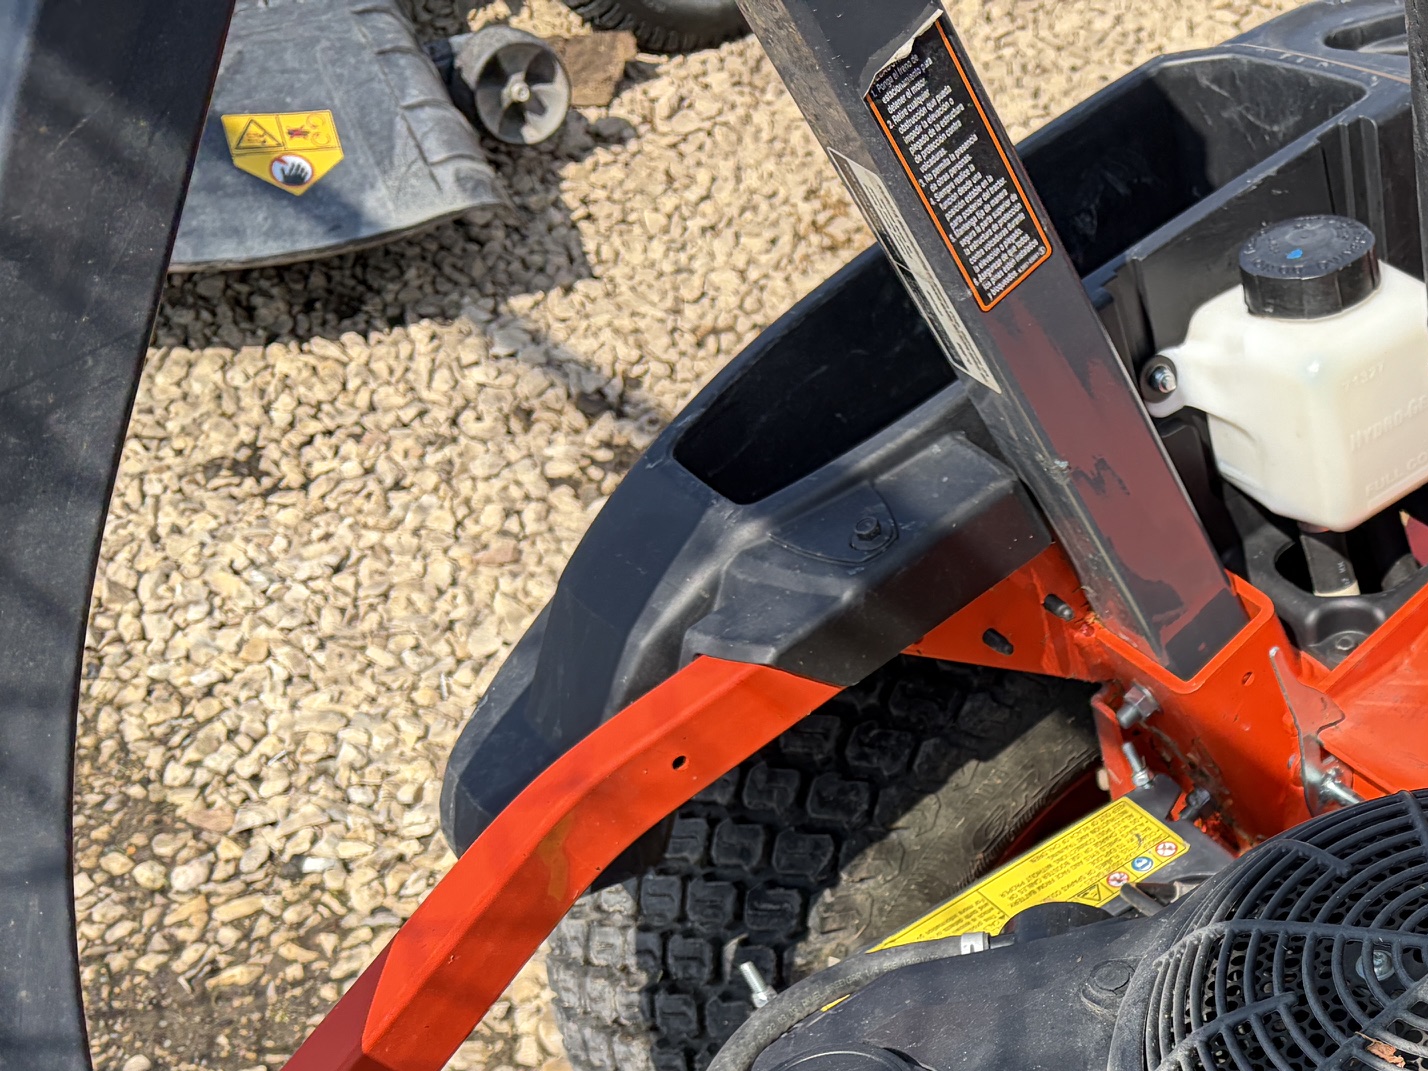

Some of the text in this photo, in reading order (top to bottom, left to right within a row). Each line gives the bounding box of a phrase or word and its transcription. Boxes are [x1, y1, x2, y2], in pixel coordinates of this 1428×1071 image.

[875, 73, 895, 95] Ponga
[890, 68, 900, 80] el
[896, 57, 912, 76] freno
[909, 51, 919, 65] de
[879, 64, 922, 105] estacionamiento
[918, 55, 934, 73] para
[885, 75, 928, 115] detener el motor.
[890, 105, 909, 125] Retire
[905, 86, 932, 115] cualquier
[896, 82, 954, 135] obstrucción que pueda
[901, 96, 955, 147] impedir la elevación o
[907, 100, 965, 157] plegado de la estructura
[912, 117, 963, 165] de protección contra
[917, 144, 948, 174] volcaduras.
[922, 170, 934, 184] No
[930, 155, 952, 179] permita
[947, 151, 956, 162] la
[952, 131, 980, 160] presencia
[928, 151, 974, 193] de otras personas.
[932, 179, 957, 204] Siempre
[951, 165, 971, 186] realice
[967, 161, 976, 173] la
[943, 172, 994, 223] posición estable en la
[955, 177, 973, 197] desde
[970, 170, 982, 184] una
[982, 201, 992, 214] de
[988, 187, 1009, 208] manera
[948, 213, 964, 231] parte
[960, 195, 985, 221] posterior
[980, 187, 992, 202] del
[958, 228, 978, 249] segura
[973, 223, 982, 234] la
[978, 213, 995, 232] parte
[1008, 190, 1018, 203] de
[962, 200, 1024, 257] la estructura de protección
[967, 247, 985, 265] contra
[981, 225, 1009, 252] volcaduras
[971, 262, 980, 274] la
[1366, 468, 1401, 496] FULL
[1034, 877, 1057, 891] FROM
[1053, 867, 1072, 880] FACE
[1068, 859, 1085, 870] AND
